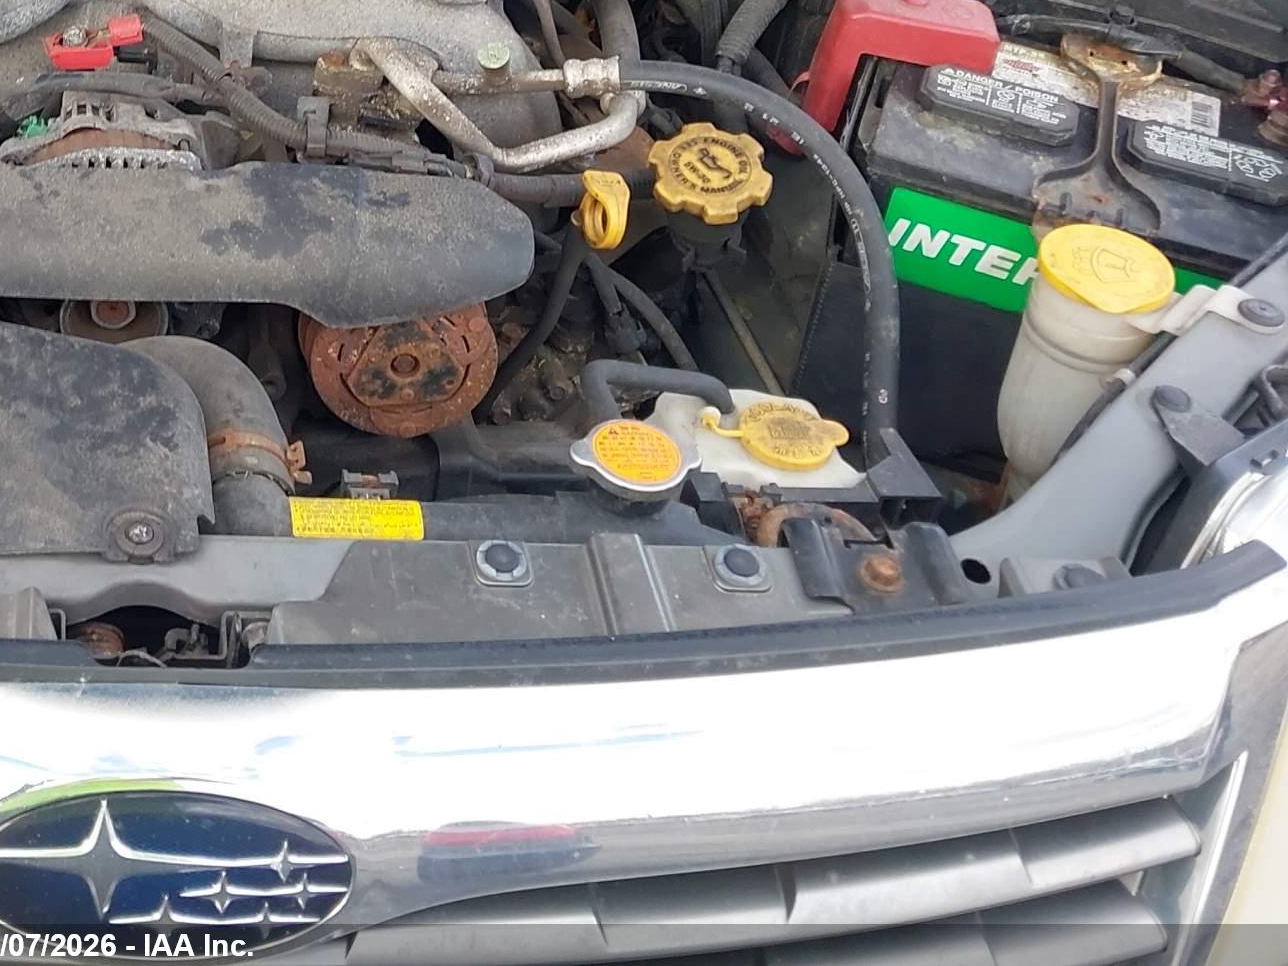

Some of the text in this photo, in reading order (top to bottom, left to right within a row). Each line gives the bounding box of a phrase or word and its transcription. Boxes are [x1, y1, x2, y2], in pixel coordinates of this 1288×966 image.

[955, 70, 1003, 89] DANGER
[1015, 86, 1059, 103] POISON
[703, 137, 743, 159] ENGINE
[737, 160, 749, 175] OIL
[699, 178, 746, 195] MANUAL
